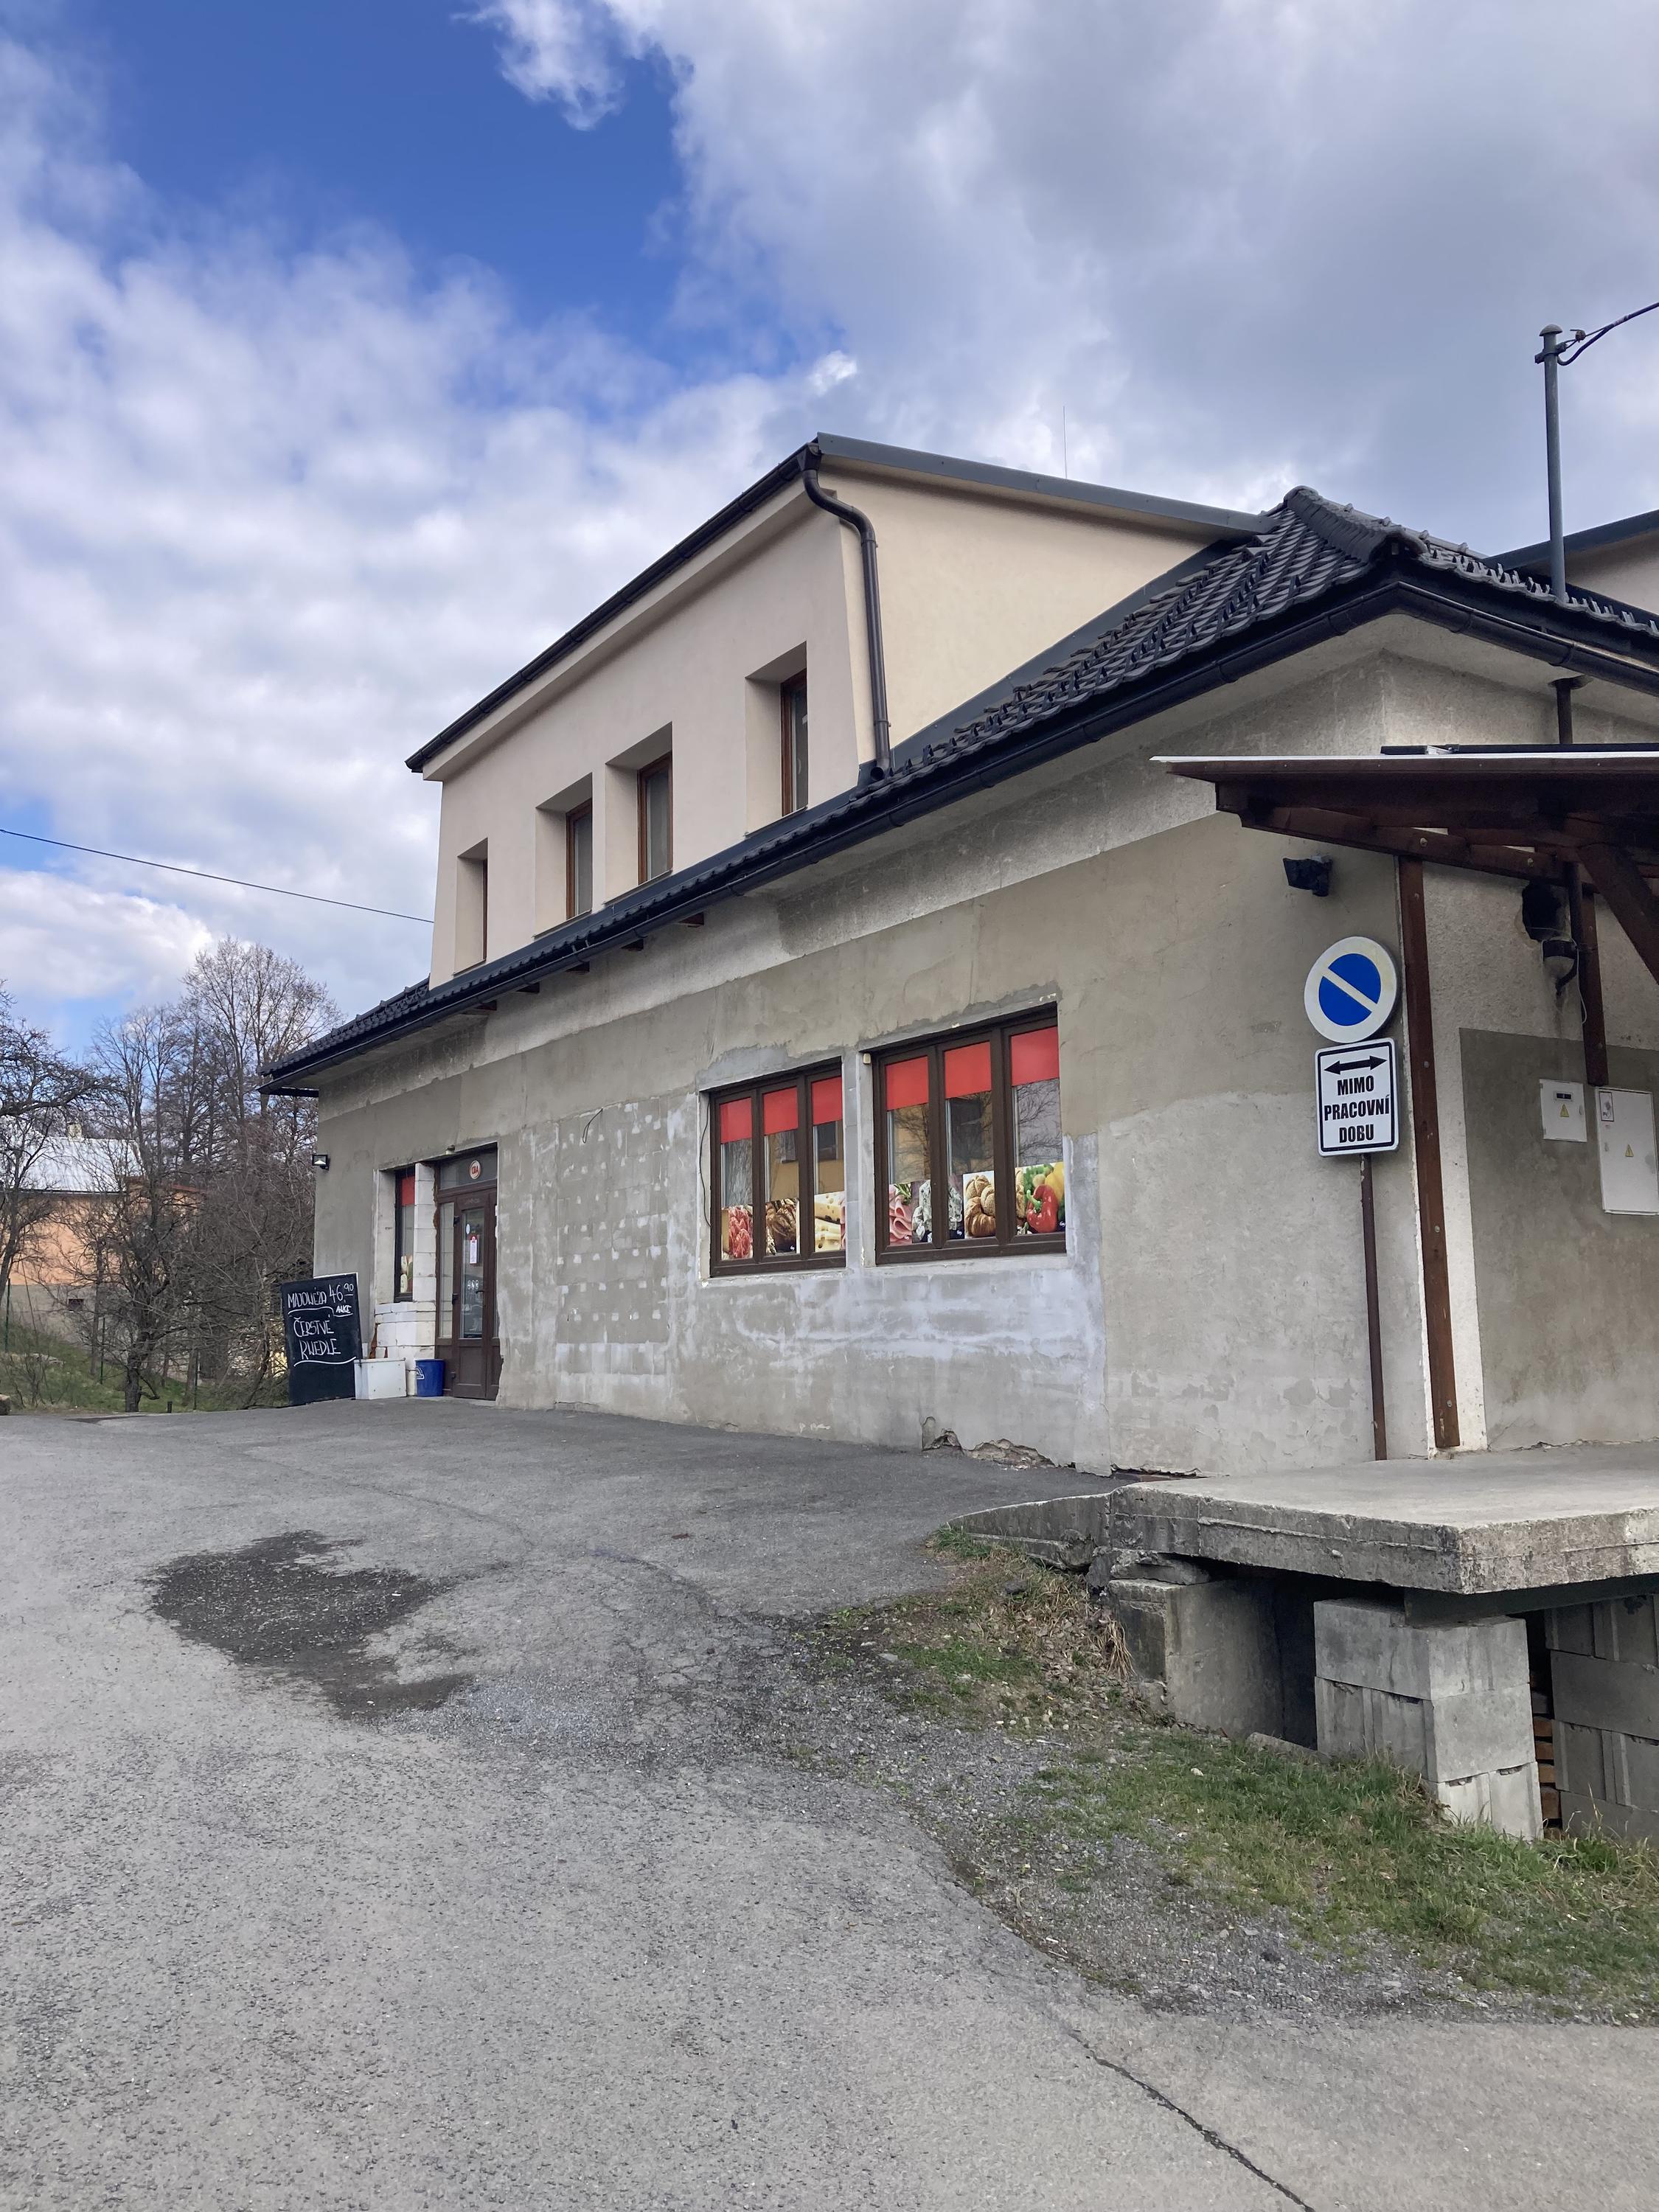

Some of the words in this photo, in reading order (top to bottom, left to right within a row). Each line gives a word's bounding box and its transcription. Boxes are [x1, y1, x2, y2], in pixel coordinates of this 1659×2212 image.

[1337, 1075, 1374, 1096] MIMO
[1324, 1094, 1390, 1121] PRACOVNÍ
[1339, 1124, 1374, 1143] DOBU
